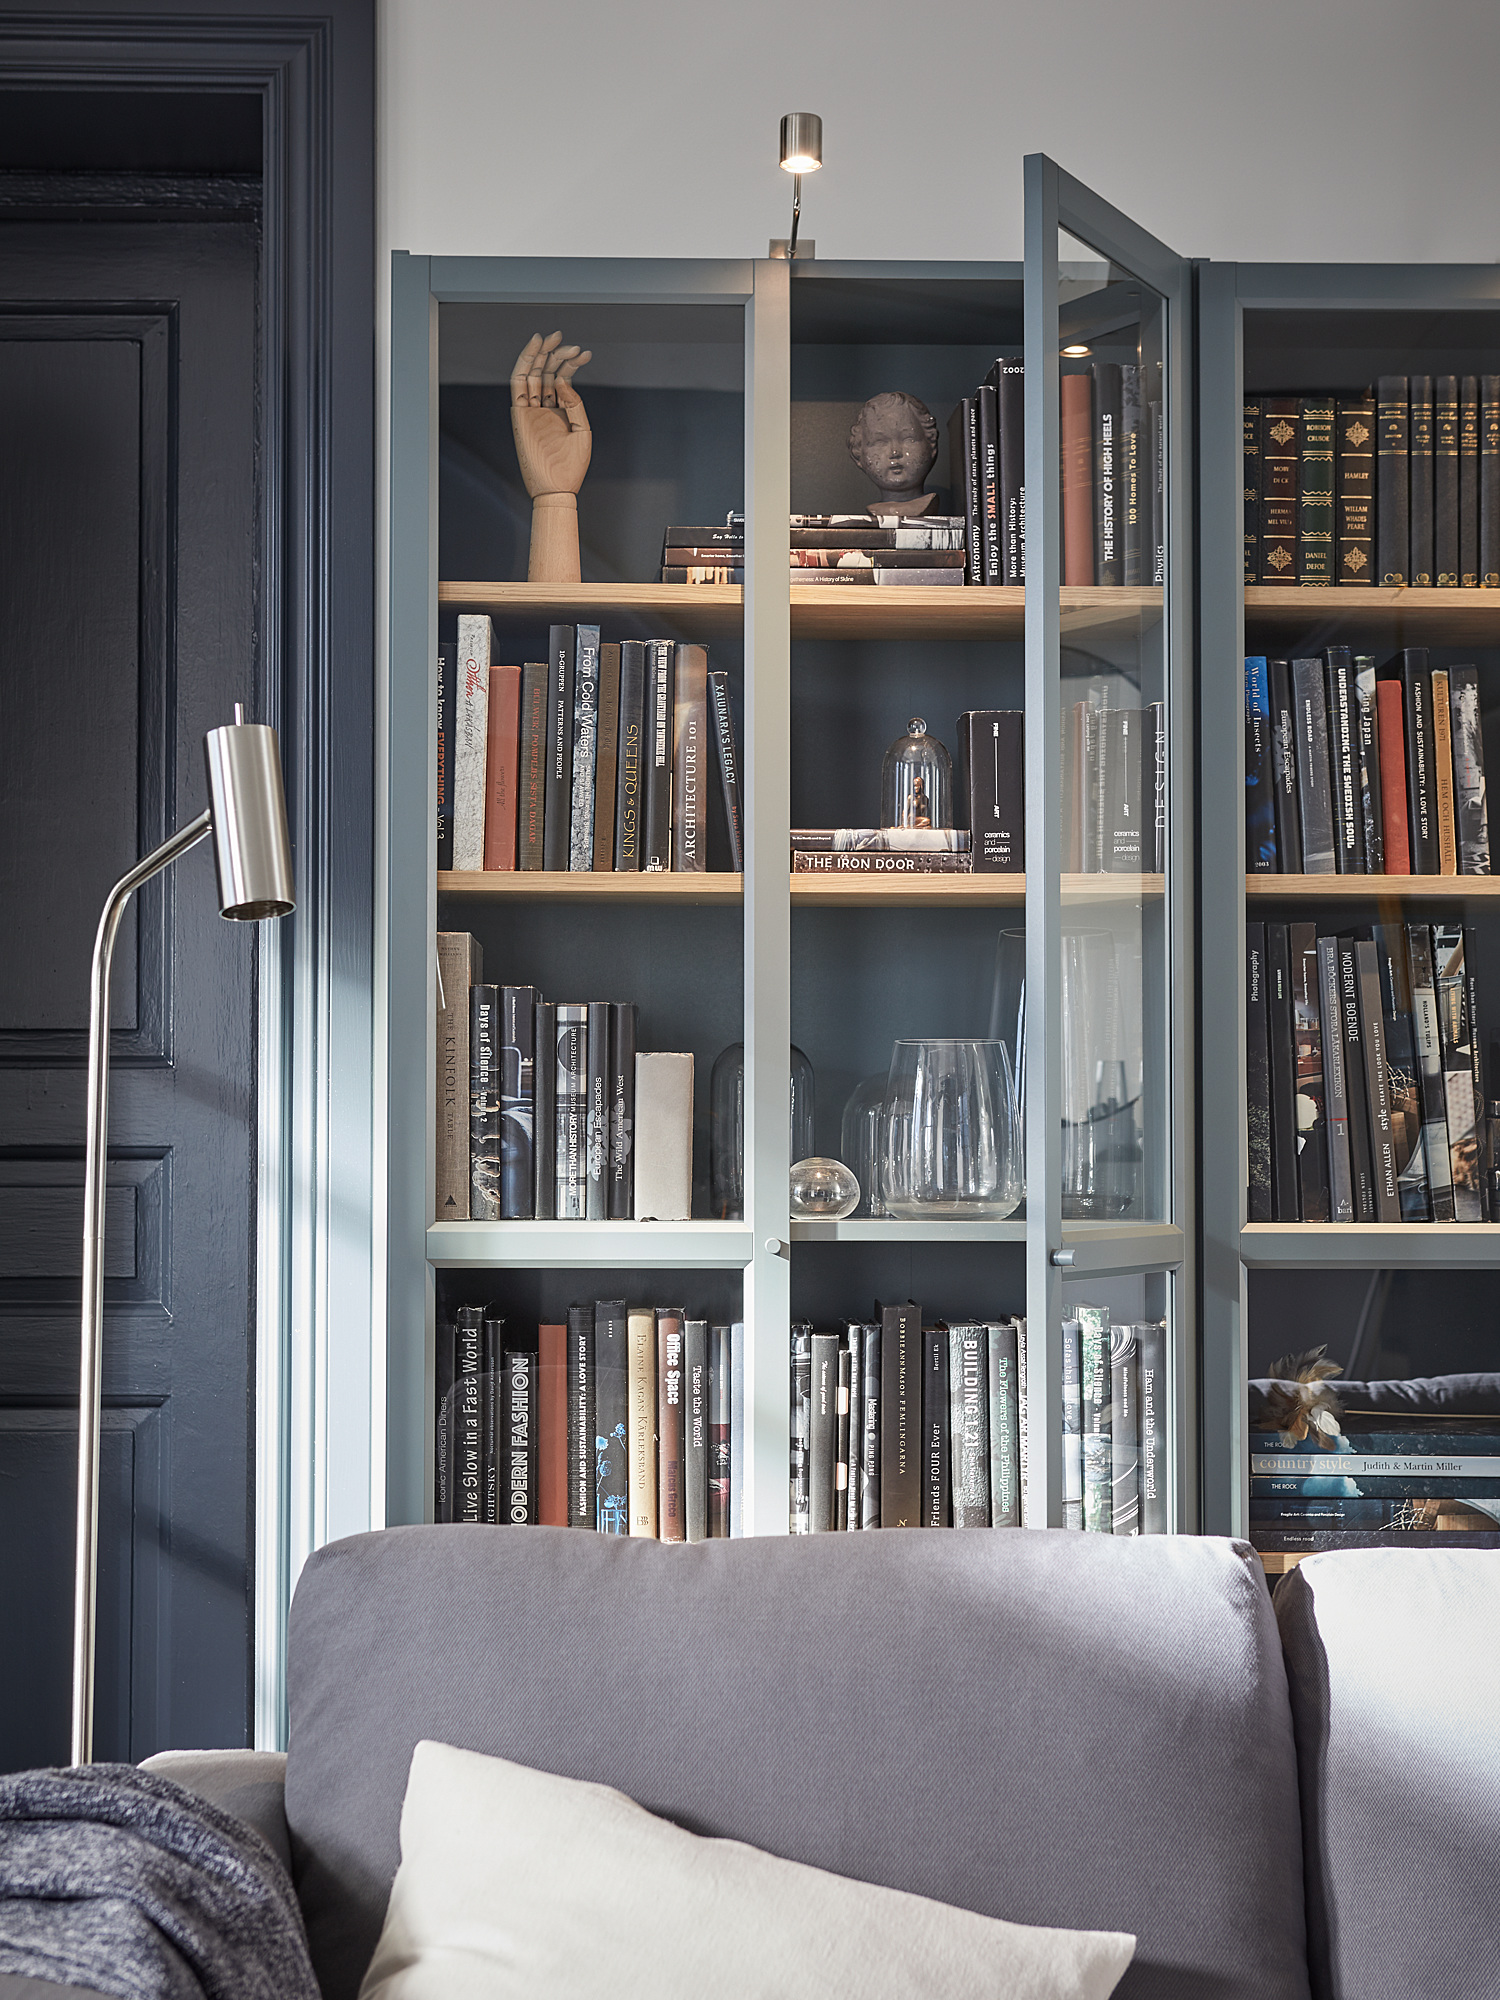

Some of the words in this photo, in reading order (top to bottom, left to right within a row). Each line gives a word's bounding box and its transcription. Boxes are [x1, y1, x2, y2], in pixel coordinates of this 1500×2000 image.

[1102, 414, 1112, 446] HEELS
[1129, 433, 1137, 456] Love
[985, 443, 997, 478] things
[1103, 447, 1113, 475] HIGH
[1129, 459, 1137, 470] To
[1103, 476, 1113, 492] OF
[1129, 473, 1137, 505] Homes
[986, 482, 996, 519] SMALL
[1008, 497, 1018, 531] History:
[987, 522, 997, 541] the
[1104, 494, 1114, 540] HISTORY
[1129, 508, 1137, 525] 100
[971, 525, 981, 582] Astronomy
[1008, 533, 1018, 553] than
[1104, 540, 1114, 561] THE
[988, 545, 1000, 576] Enjoy
[1009, 557, 1018, 578] More
[558, 650, 566, 692] 10-GRUPPEN
[583, 647, 594, 677] From
[581, 681, 593, 710] Cold
[1251, 667, 1260, 698] World
[1414, 683, 1422, 711] FASHION
[557, 700, 565, 736] PATTERNS
[1253, 702, 1262, 713] of
[1337, 668, 1350, 752] UNDERSTANDING
[1436, 681, 1447, 726] KULTUREN
[580, 714, 592, 757] Waters
[687, 720, 697, 741] 101
[1254, 717, 1263, 754] Insects
[1280, 710, 1290, 750] European
[1361, 716, 1372, 745] Japan
[556, 753, 564, 780] PEOPLE
[624, 724, 638, 795] QUEENS
[722, 746, 735, 784] LEGACY
[1282, 751, 1293, 794] Escapades
[1342, 754, 1351, 775] THE
[1417, 732, 1426, 787] SUSTAINABILITY:
[529, 782, 538, 808] SISTA
[685, 745, 696, 859] ARCHITECTURE
[1343, 775, 1355, 821] SWEDISH
[1441, 779, 1450, 800] HEM
[1420, 797, 1428, 815] LOVE
[1442, 802, 1451, 821] OCH
[528, 811, 537, 844] DAGAR
[622, 810, 635, 858] KINGS
[1346, 821, 1356, 849] SOUL
[1421, 817, 1429, 840] STORY
[807, 858, 832, 869] THE
[837, 858, 870, 869] IRON
[875, 859, 915, 870] DOOR
[984, 847, 1010, 855] porcelain
[1113, 845, 1139, 855] porcelain
[1327, 947, 1335, 964] BRA
[1251, 950, 1259, 1002] Photography
[1328, 966, 1338, 1004] BÖCKERS
[1342, 952, 1355, 998] MODERNT
[479, 1004, 490, 1029] Days
[1330, 1005, 1338, 1033] STORA
[1346, 1002, 1359, 1042] BOENDE
[480, 1032, 490, 1043] of
[445, 1036, 456, 1106] KINFOLK
[480, 1046, 490, 1084] Silence
[1332, 1033, 1343, 1098] LÄKARLEXIKON
[616, 1074, 625, 1096] West
[593, 1077, 603, 1129] Escapades
[616, 1098, 624, 1139] American
[1336, 1123, 1345, 1136] 1
[1378, 1109, 1390, 1130] style
[592, 1131, 604, 1176] European
[616, 1141, 624, 1163] Wild
[1383, 1143, 1393, 1168] ALLEN
[616, 1164, 624, 1181] The
[1386, 1173, 1396, 1196] ETHAN
[462, 1328, 478, 1373] World
[578, 1335, 587, 1361] STORY
[666, 1333, 681, 1367] Office
[1065, 1338, 1074, 1363] Sofas
[1092, 1327, 1103, 1350] Days
[578, 1362, 587, 1385] LOVE
[999, 1357, 1008, 1378] The
[1093, 1354, 1103, 1365] of
[664, 1370, 680, 1405] Space
[693, 1365, 703, 1396] Taste
[964, 1341, 978, 1416] BUILDING
[1065, 1366, 1074, 1384] that
[1093, 1368, 1104, 1405] Silence
[439, 1396, 447, 1427] Diners
[462, 1378, 478, 1415] Fast
[511, 1358, 529, 1447] FASHION
[693, 1397, 702, 1415] the
[999, 1378, 1008, 1420] Flowers
[1146, 1396, 1154, 1416] and
[467, 1419, 478, 1429] a
[578, 1393, 588, 1460] SUSTAINABILITY:
[867, 1398, 878, 1428] Mastering
[1146, 1418, 1155, 1436] the
[463, 1433, 478, 1447] in
[693, 1416, 703, 1447] World
[931, 1423, 940, 1448] Ever
[1000, 1423, 1009, 1434] of
[1000, 1434, 1010, 1453] the
[438, 1430, 447, 1474] American
[931, 1452, 940, 1482] FOUR
[1259, 1457, 1318, 1476] country
[1319, 1456, 1350, 1474] style
[1361, 1461, 1390, 1472] Judith
[1393, 1462, 1401, 1470] &
[1403, 1461, 1433, 1471] Martin
[1436, 1462, 1463, 1471] Miller
[463, 1450, 478, 1488] Slow
[578, 1460, 587, 1479] AND
[1000, 1454, 1010, 1513] Philippines
[1147, 1438, 1157, 1500] Underworld
[438, 1476, 447, 1503] Iconic
[510, 1452, 528, 1526] ODERN
[578, 1480, 588, 1516] FASHION
[463, 1491, 478, 1522] Live
[931, 1485, 940, 1527] Friends
